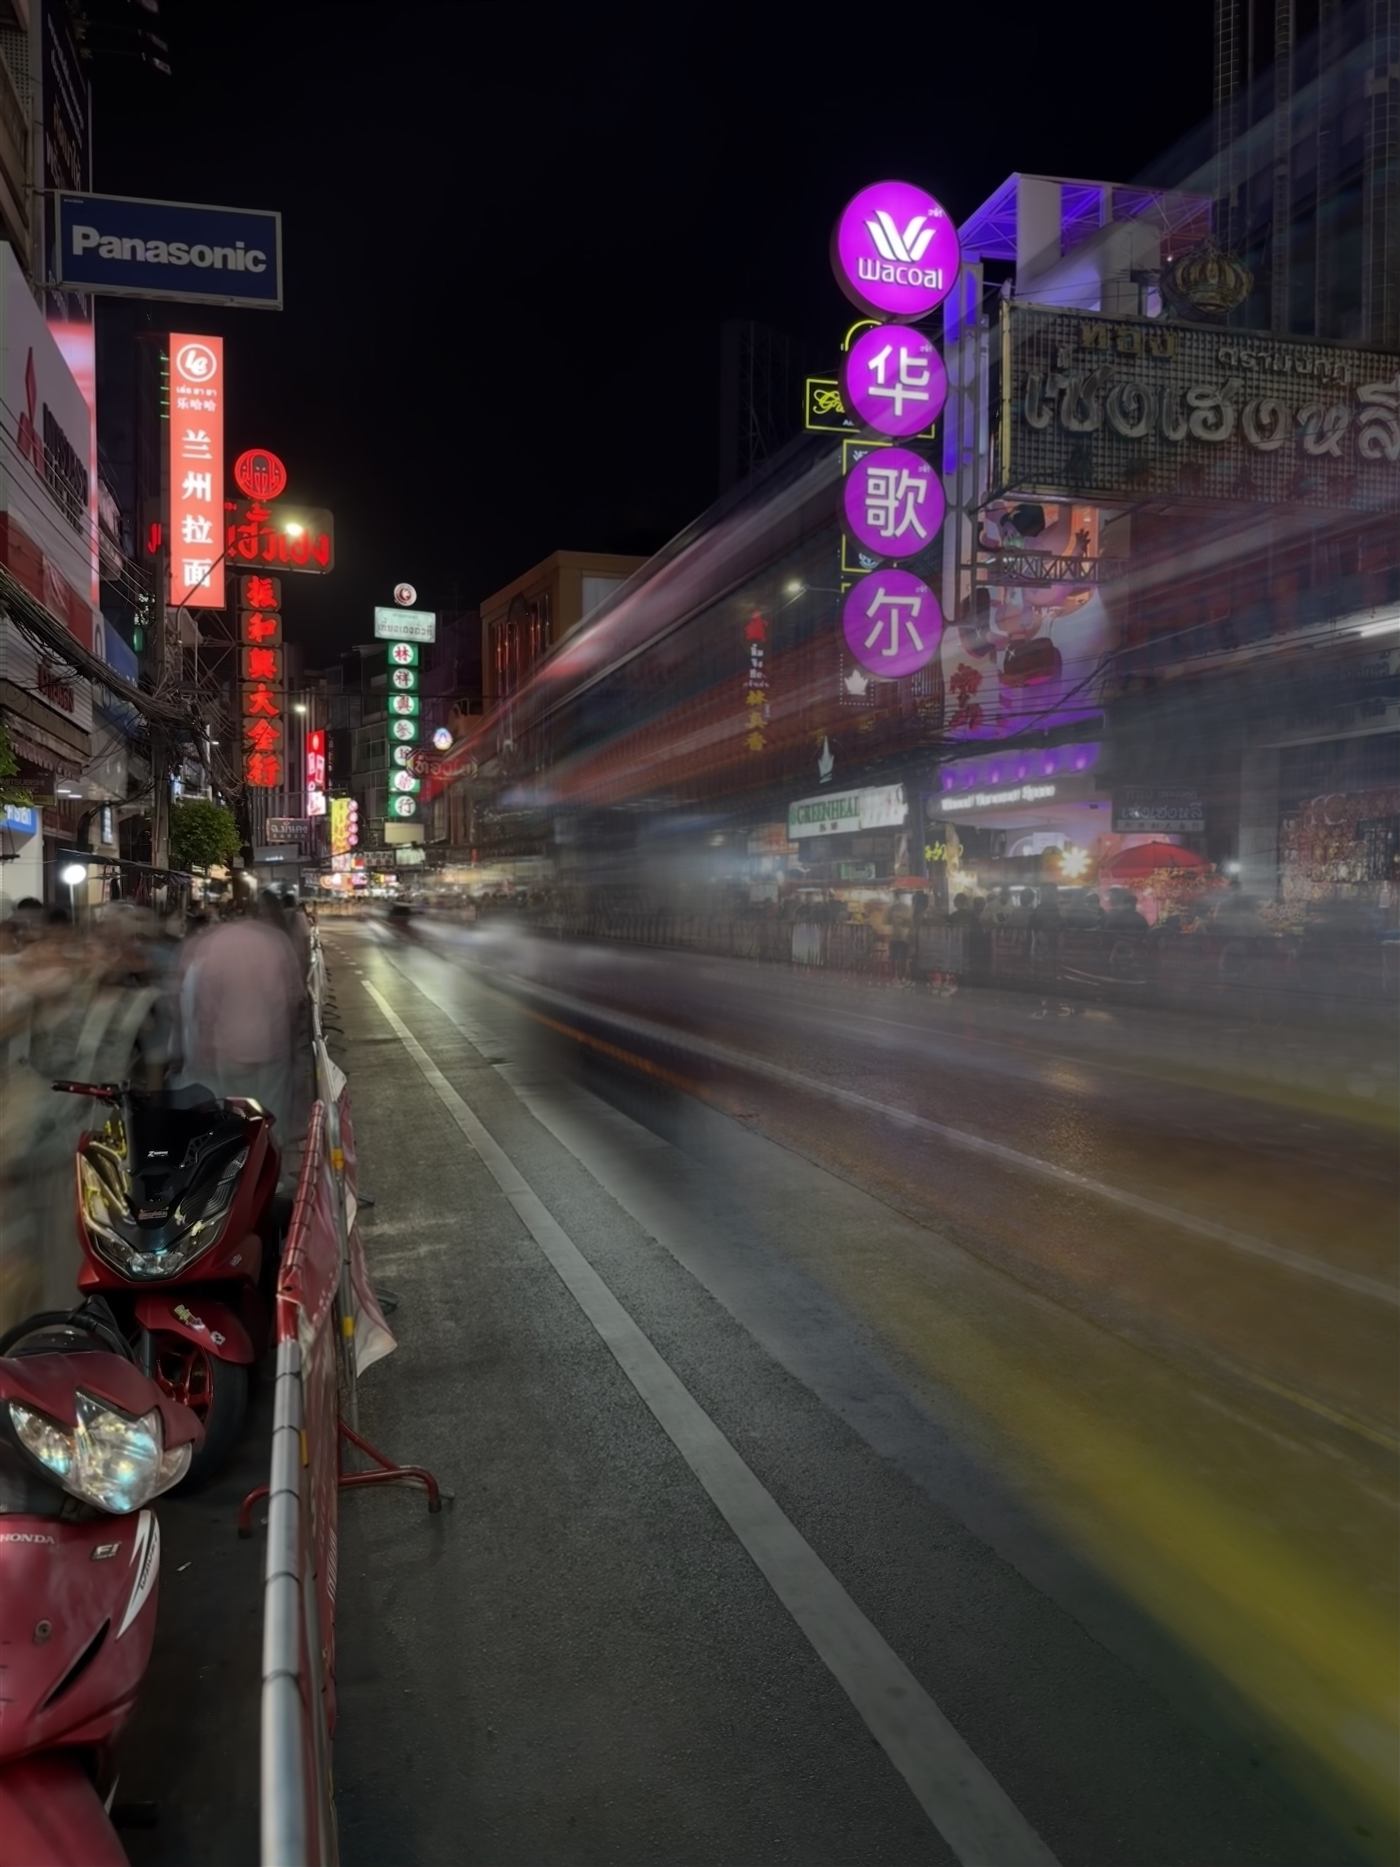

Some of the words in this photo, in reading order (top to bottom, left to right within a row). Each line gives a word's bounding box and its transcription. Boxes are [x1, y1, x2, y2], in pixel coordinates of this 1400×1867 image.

[72, 224, 267, 273] Panasonic
[858, 257, 942, 290] Wacoal
[182, 429, 213, 588] 兰州拉面
[864, 344, 931, 658] 华歌尔
[0, 1533, 55, 1544] HONDA
